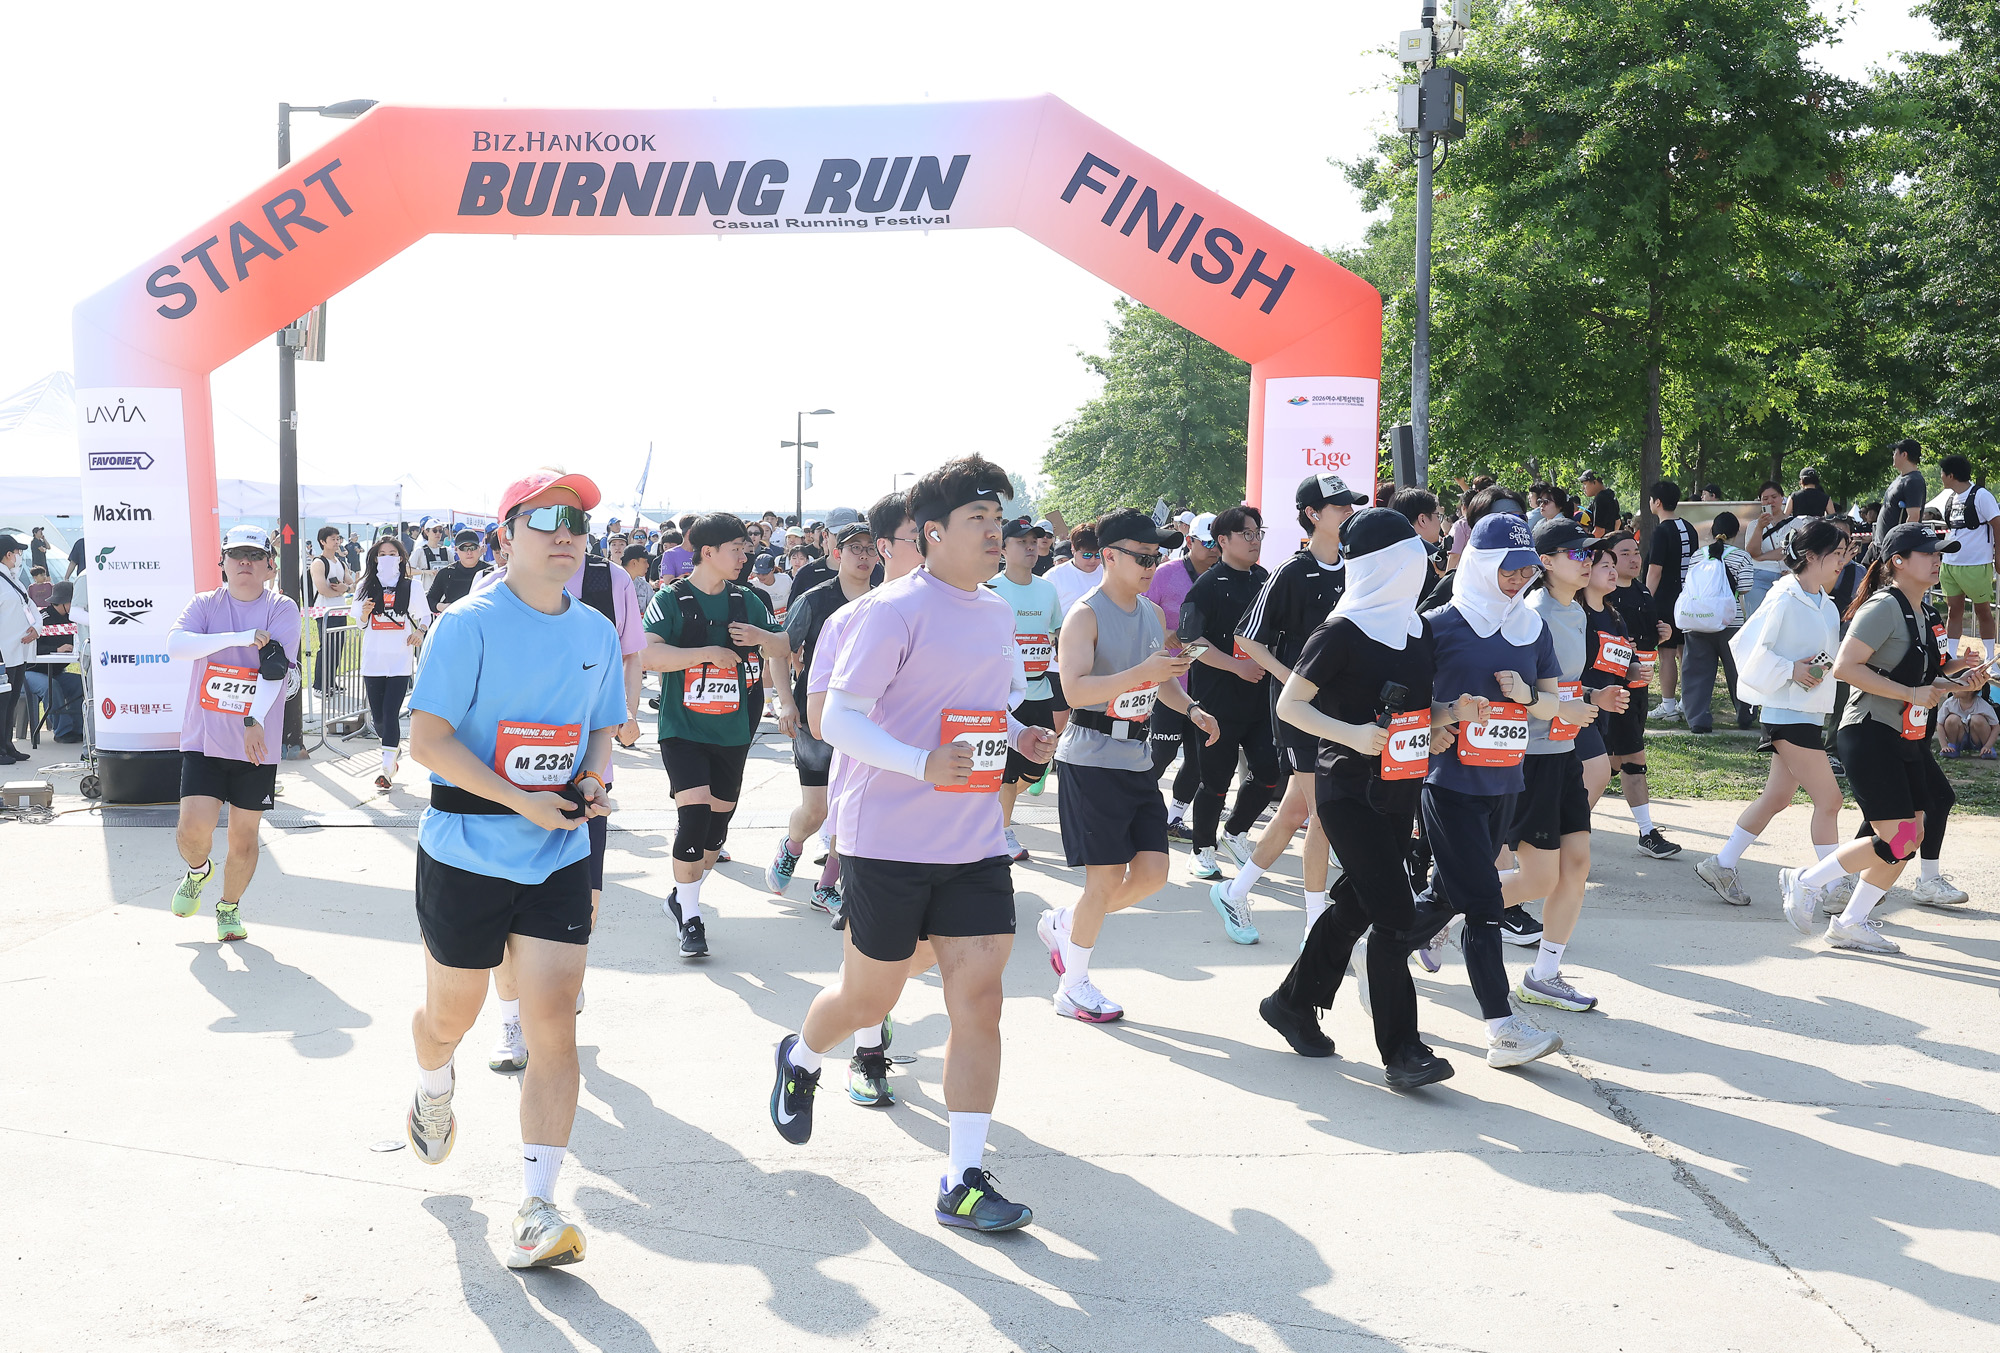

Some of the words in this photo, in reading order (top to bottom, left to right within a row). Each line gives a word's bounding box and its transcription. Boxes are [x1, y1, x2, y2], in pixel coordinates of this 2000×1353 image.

[458, 159, 789, 216] BURNING
[805, 154, 971, 214] RUN
[712, 219, 779, 230] Casual
[786, 216, 868, 230] Running
[874, 214, 951, 226] Festival
[145, 158, 354, 320] START
[1060, 152, 1296, 315] FINISH
[92, 456, 142, 468] FAVONEX
[1302, 448, 1351, 471] Tage
[93, 501, 153, 521] Maxim
[108, 561, 161, 570] NEWTREE
[104, 598, 153, 609] Reebok
[211, 682, 221, 690] M
[223, 682, 257, 695] 2170
[708, 682, 737, 693] 2704
[120, 703, 173, 715] 롯데웰푸드
[221, 700, 242, 710] D-153
[1120, 699, 1129, 708] M
[503, 726, 540, 736] BURNING
[540, 729, 557, 737] RUN
[1474, 727, 1486, 737] W
[1489, 725, 1527, 739] 4362
[1395, 740, 1406, 750] W
[515, 756, 530, 770] M
[534, 752, 574, 771] 2326
[1501, 1039, 1518, 1048] HOKA
